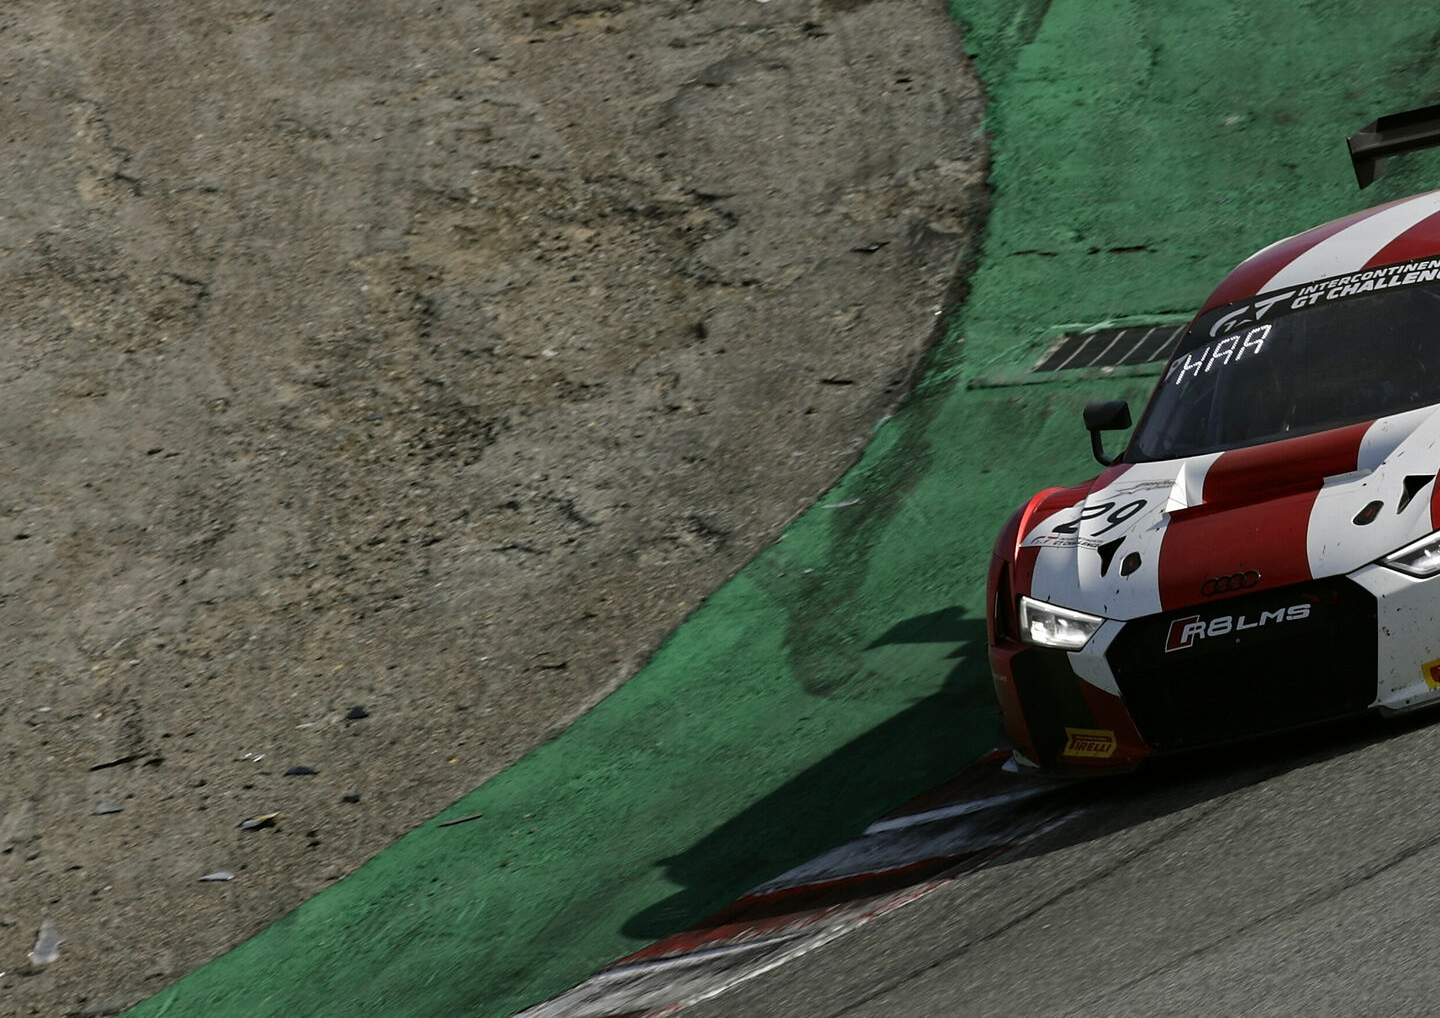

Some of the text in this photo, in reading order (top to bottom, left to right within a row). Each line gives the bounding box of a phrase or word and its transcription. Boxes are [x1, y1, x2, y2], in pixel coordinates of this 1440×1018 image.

[1290, 293, 1326, 311] GT
[1175, 324, 1272, 385] HAA
[1052, 499, 1147, 536] 29
[1069, 733, 1113, 752] PIRELLI
